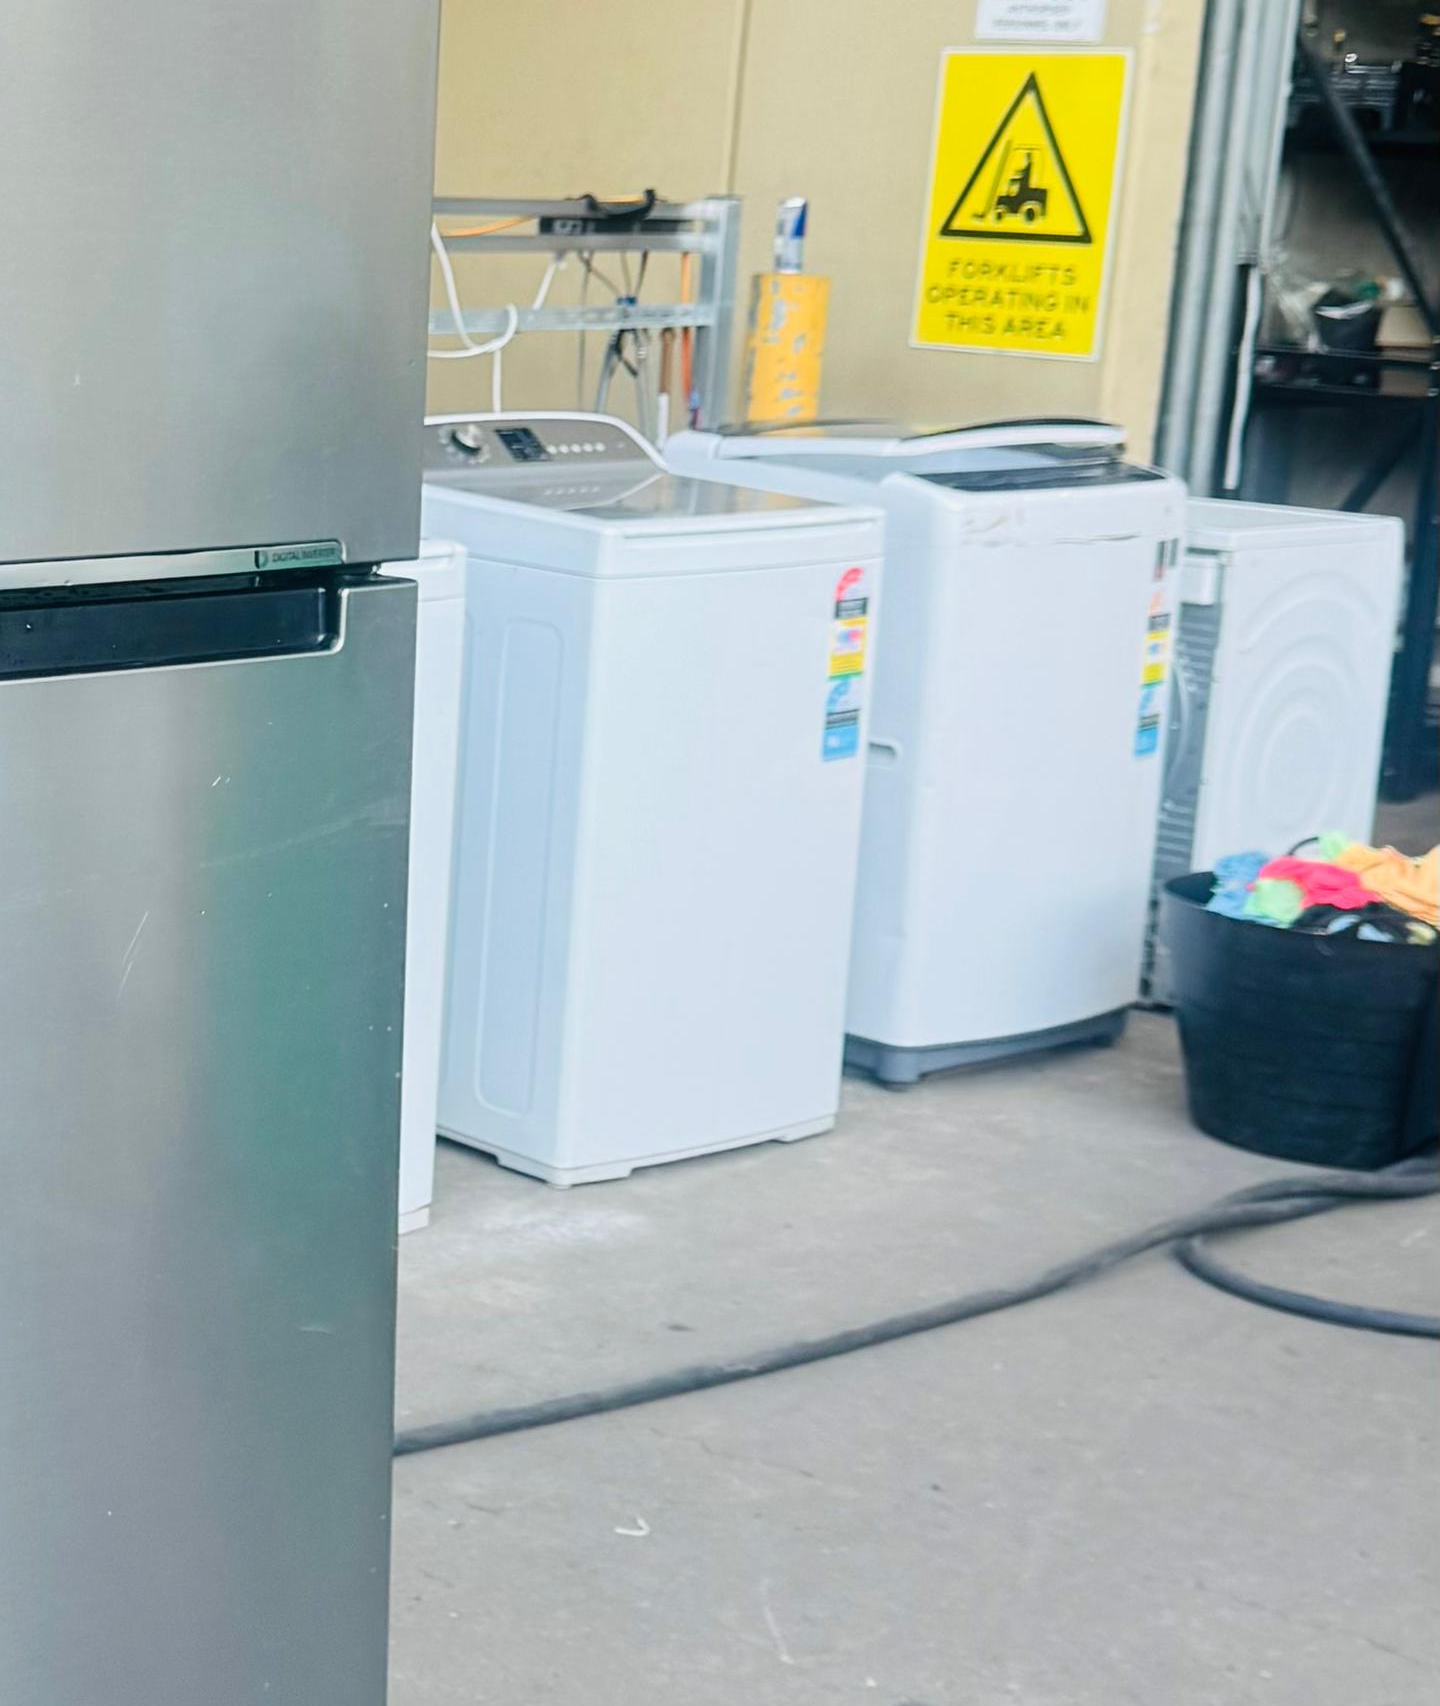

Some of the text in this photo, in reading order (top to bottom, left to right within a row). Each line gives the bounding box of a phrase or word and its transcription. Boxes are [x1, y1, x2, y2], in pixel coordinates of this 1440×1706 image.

[946, 258, 1076, 286] FORKLIFTS
[926, 284, 1090, 313] OPERATING IN
[944, 311, 1066, 340] THIS AREA
